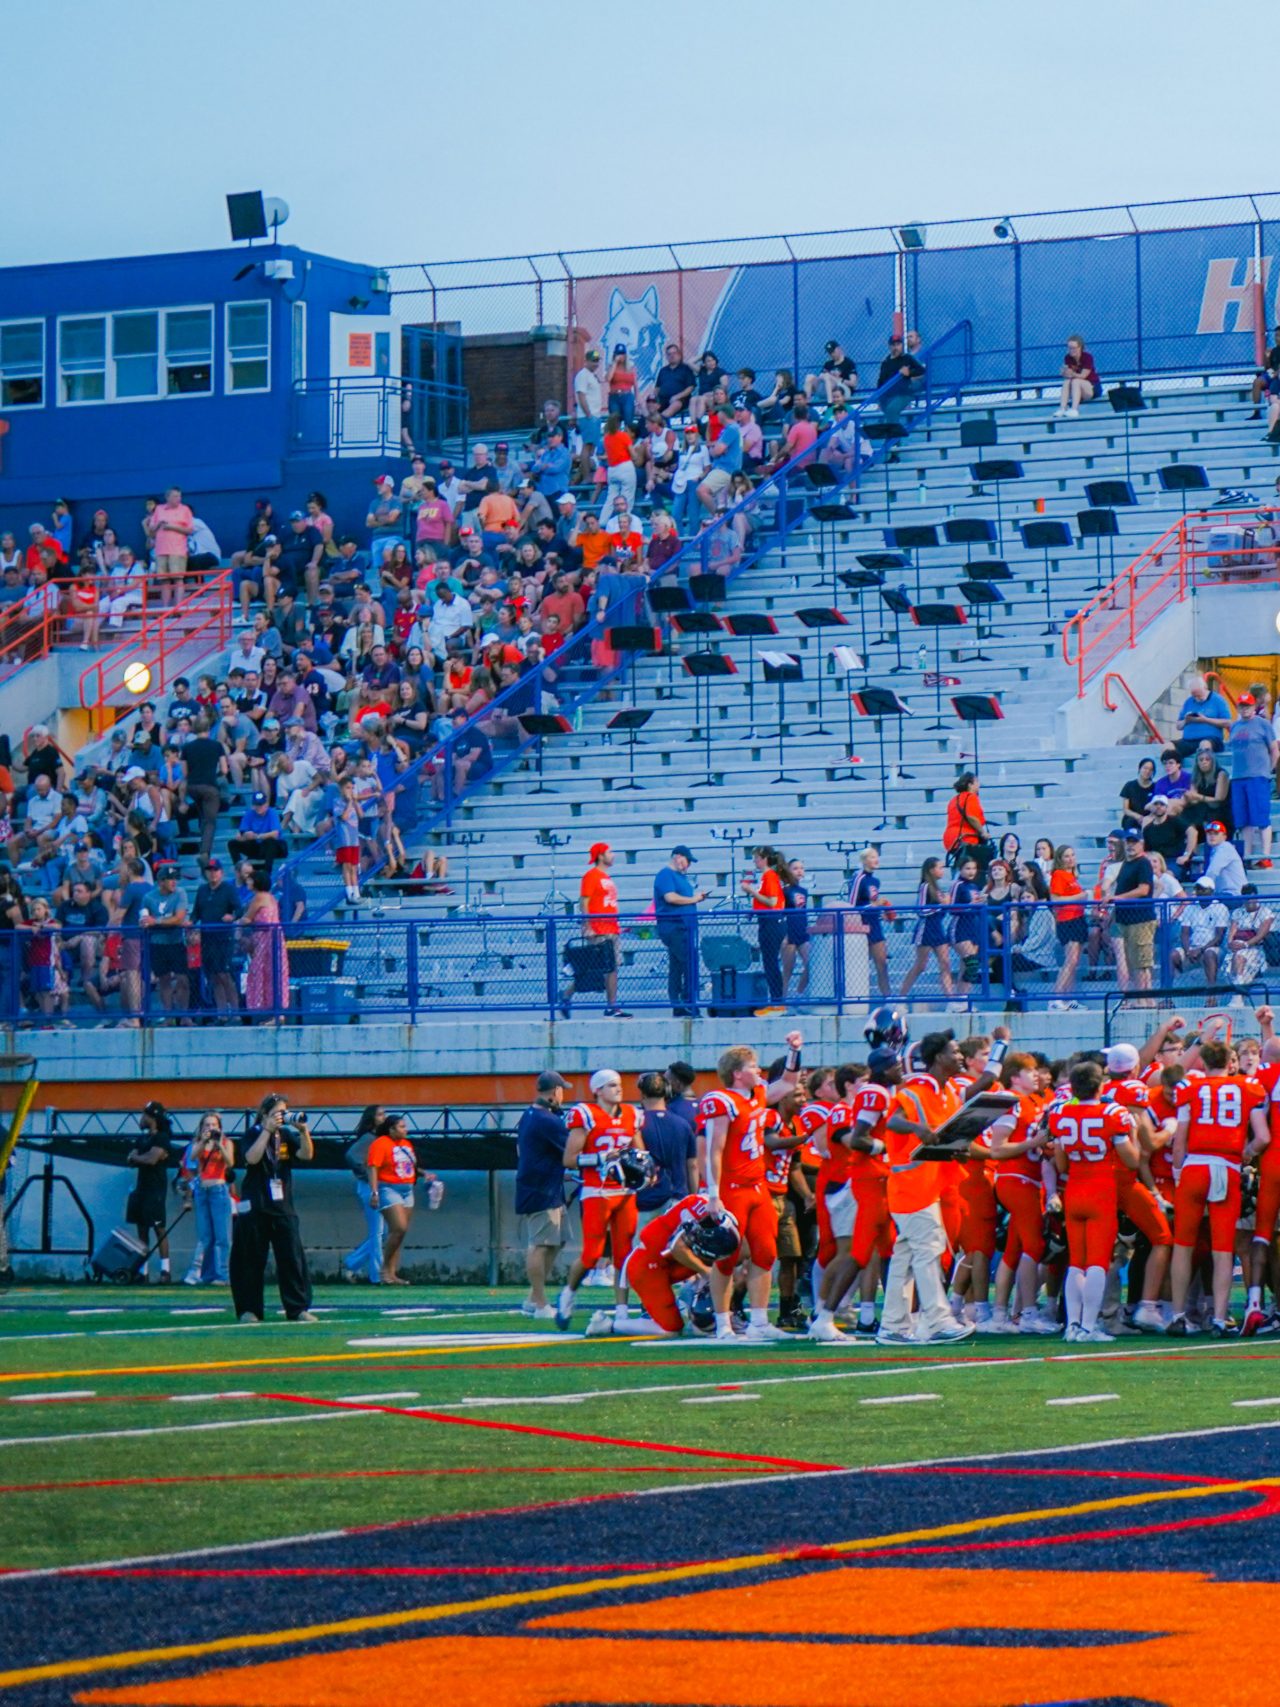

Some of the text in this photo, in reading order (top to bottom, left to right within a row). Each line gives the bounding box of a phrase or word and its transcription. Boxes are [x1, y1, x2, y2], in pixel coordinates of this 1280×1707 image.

[702, 1100, 717, 1115] 43
[863, 1093, 877, 1108] 17
[1198, 1084, 1241, 1127] 18
[1057, 1117, 1107, 1161] 25
